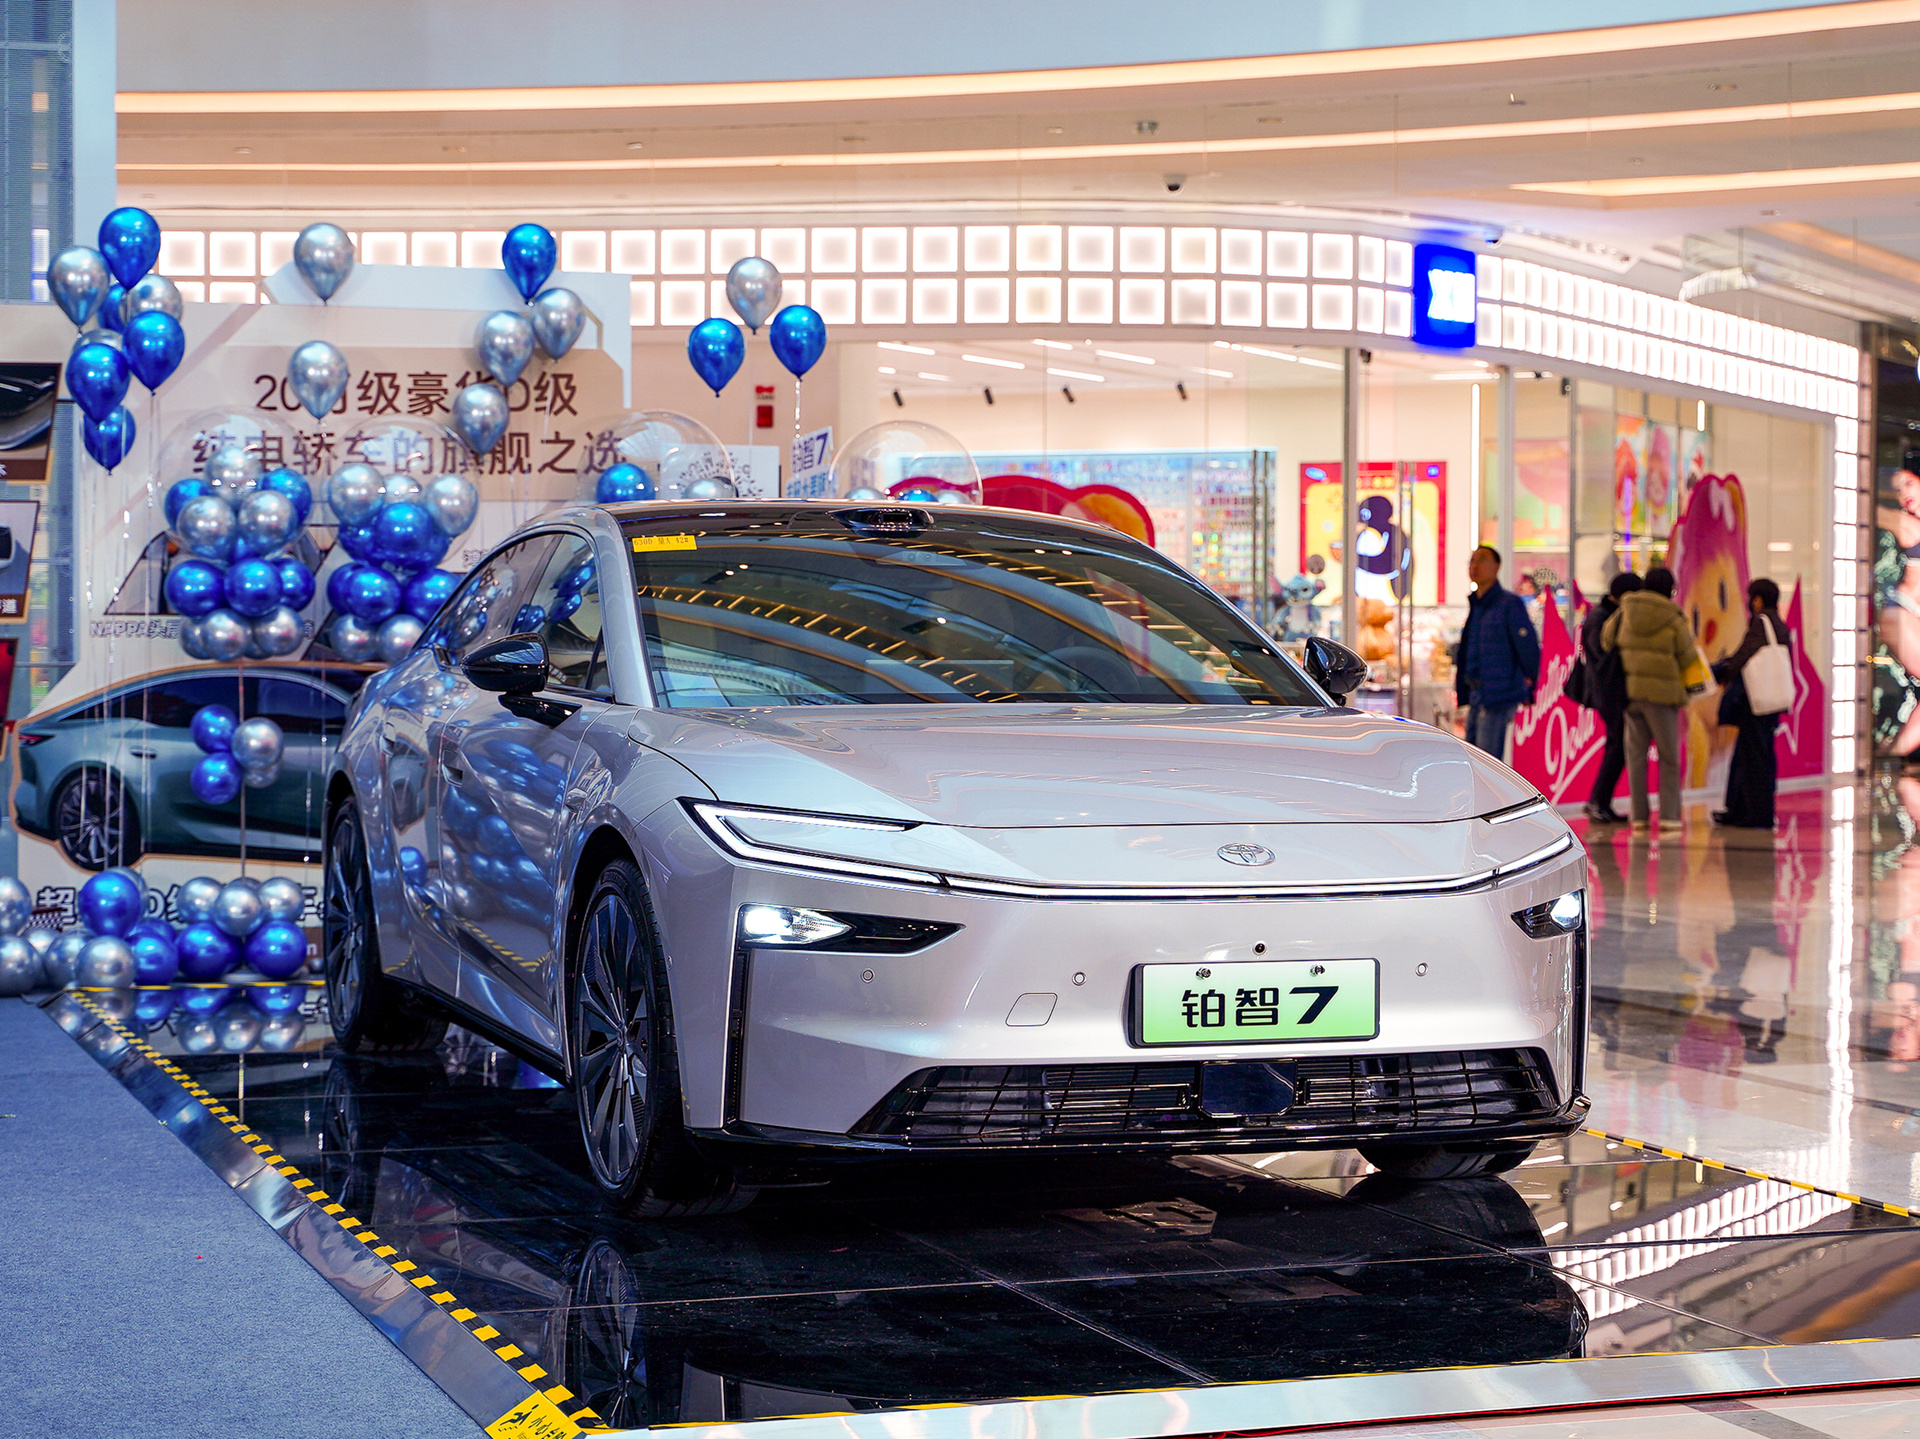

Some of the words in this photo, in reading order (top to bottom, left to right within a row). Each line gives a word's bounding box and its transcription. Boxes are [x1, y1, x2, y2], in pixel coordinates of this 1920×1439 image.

[253, 370, 578, 416] 20级豪D级
[1181, 985, 1339, 1028] 铂智7
